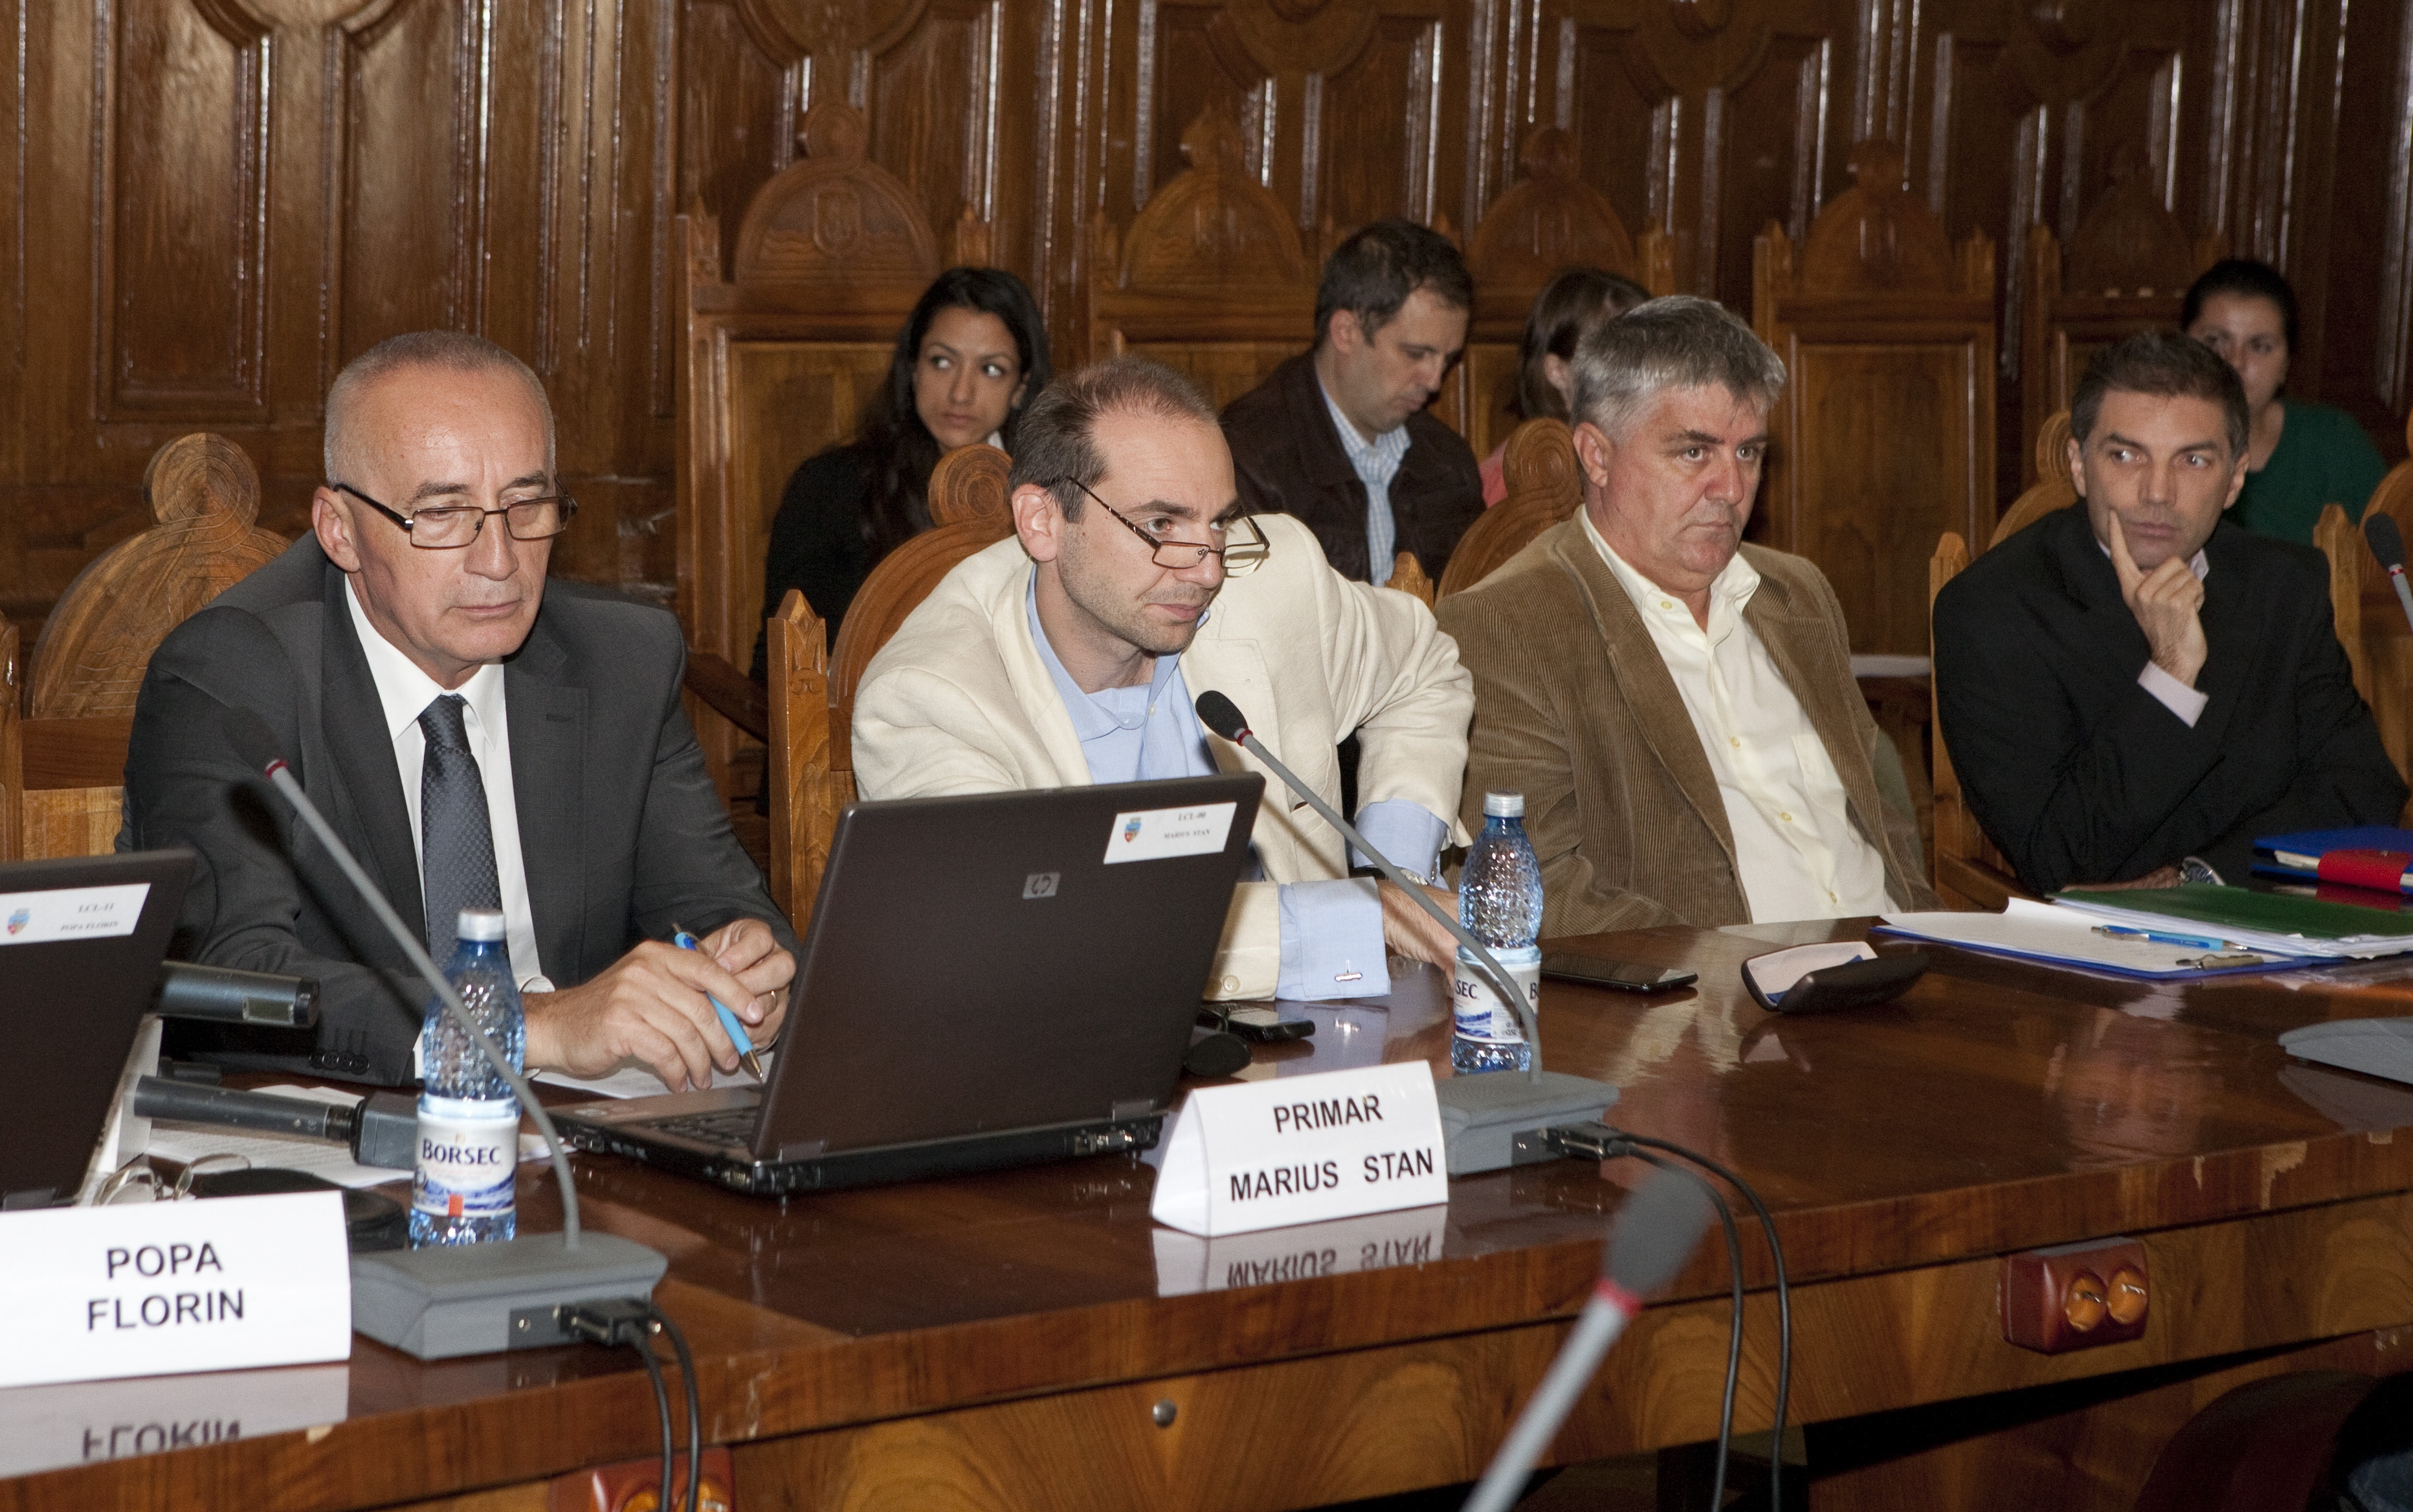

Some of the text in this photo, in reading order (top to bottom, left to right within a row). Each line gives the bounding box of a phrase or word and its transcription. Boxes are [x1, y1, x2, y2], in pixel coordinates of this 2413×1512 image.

[1273, 1095, 1384, 1133] PRIMAR
[423, 1138, 501, 1166] BORSEC
[1230, 1148, 1434, 1202] MARIUS STAN
[107, 1241, 222, 1280] POPA
[87, 1289, 244, 1331] FLORIN
